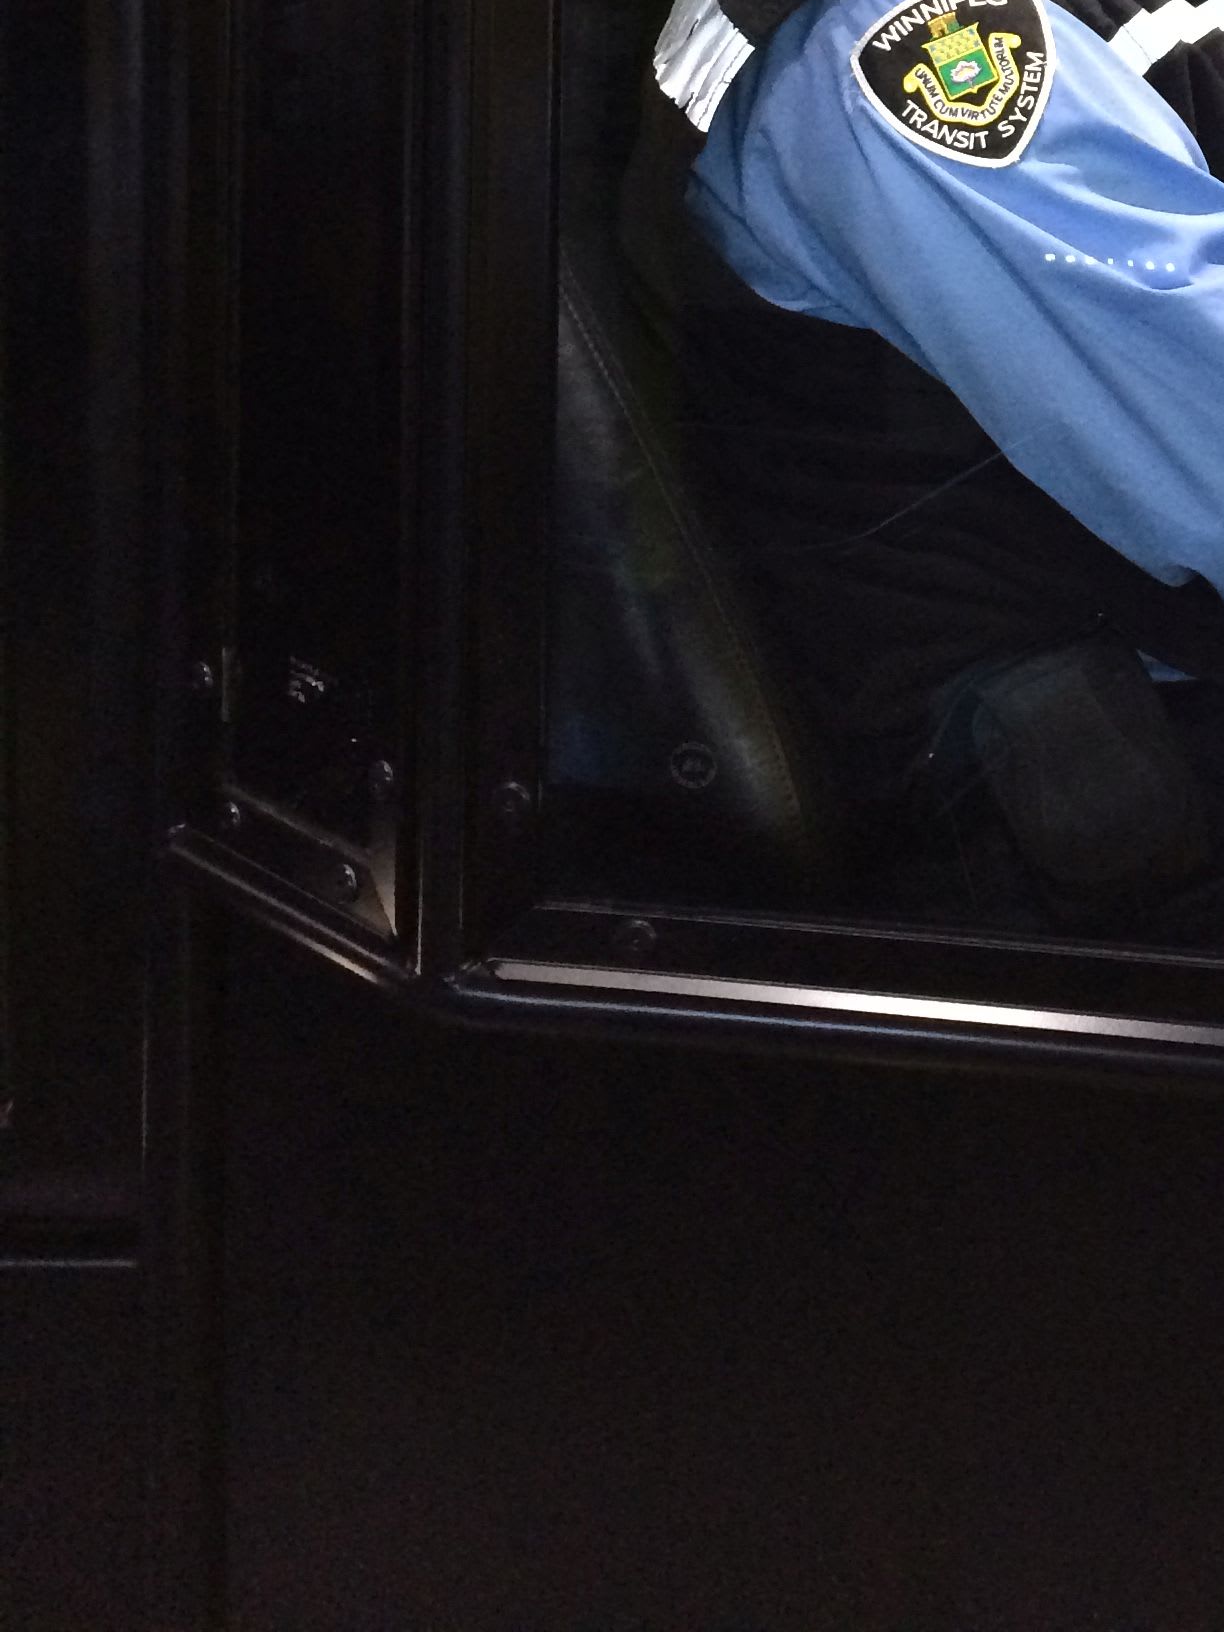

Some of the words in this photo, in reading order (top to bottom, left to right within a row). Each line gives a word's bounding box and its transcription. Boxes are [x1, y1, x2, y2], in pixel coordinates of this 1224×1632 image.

[901, 100, 989, 150] TRANSIT
[997, 51, 1046, 138] SYSTEM
[914, 68, 939, 99] UNUM
[933, 99, 959, 117] CUM
[960, 93, 1003, 120] VIRTUTE
